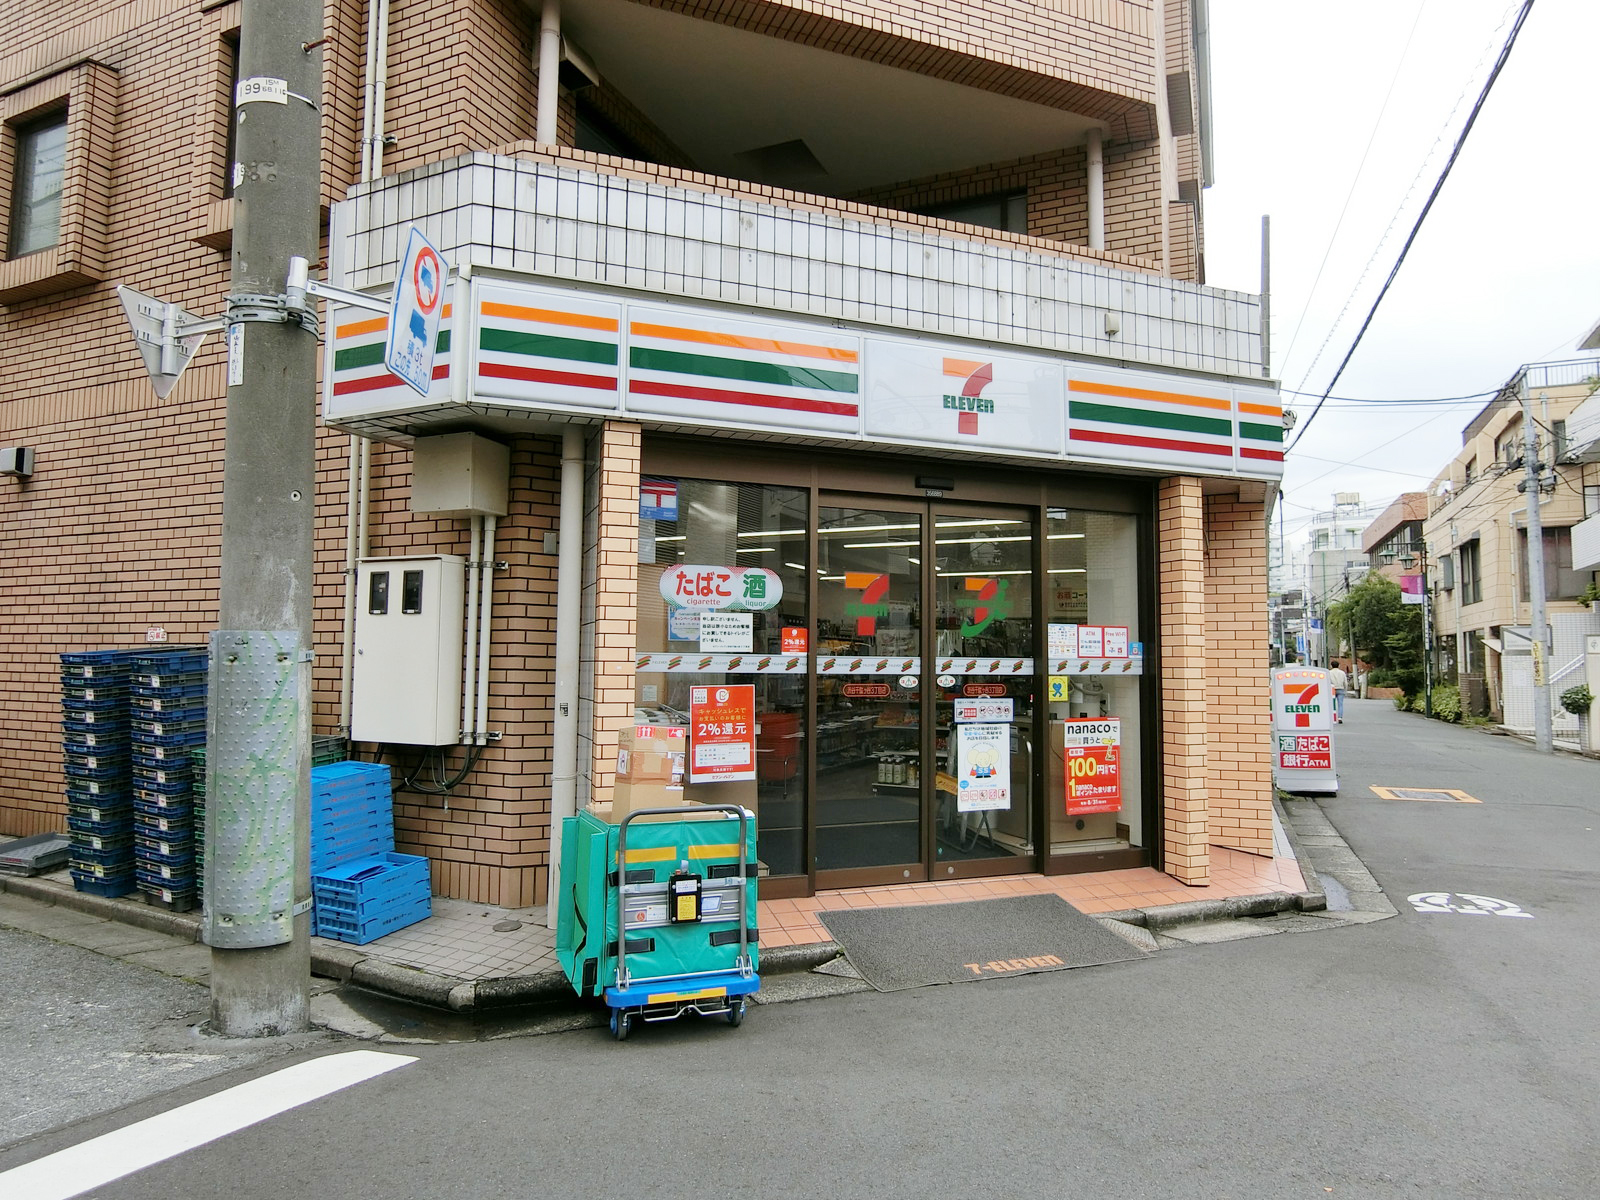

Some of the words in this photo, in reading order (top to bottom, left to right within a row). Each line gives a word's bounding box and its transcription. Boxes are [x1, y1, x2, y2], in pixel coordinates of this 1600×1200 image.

[675, 570, 732, 597] たばこ
[742, 573, 767, 599] 酒
[686, 598, 721, 607] cigarette
[745, 600, 767, 608] liquor
[698, 722, 747, 736] 2%還元
[1082, 736, 1101, 745] 買うと
[1280, 737, 1296, 751] 酒
[1297, 736, 1330, 751] たばこ
[1282, 753, 1329, 768] 銀行ATM
